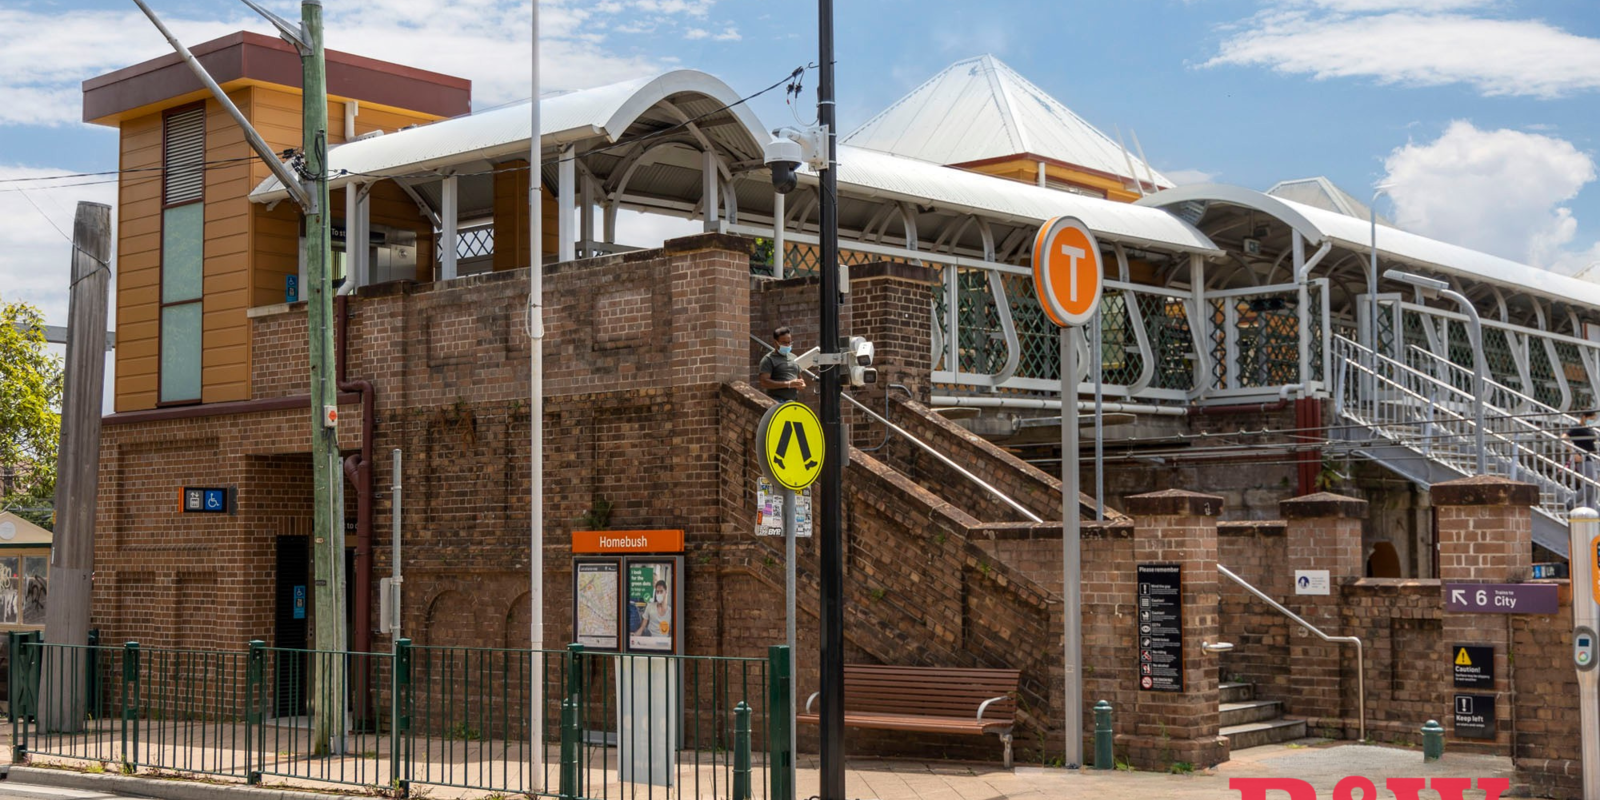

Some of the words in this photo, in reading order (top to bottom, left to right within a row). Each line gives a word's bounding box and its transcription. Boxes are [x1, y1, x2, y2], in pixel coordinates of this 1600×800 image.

[331, 228, 338, 236] To
[1061, 244, 1085, 302] T
[600, 536, 647, 548] Homebush
[1476, 590, 1487, 606] 6
[1494, 596, 1516, 609] City
